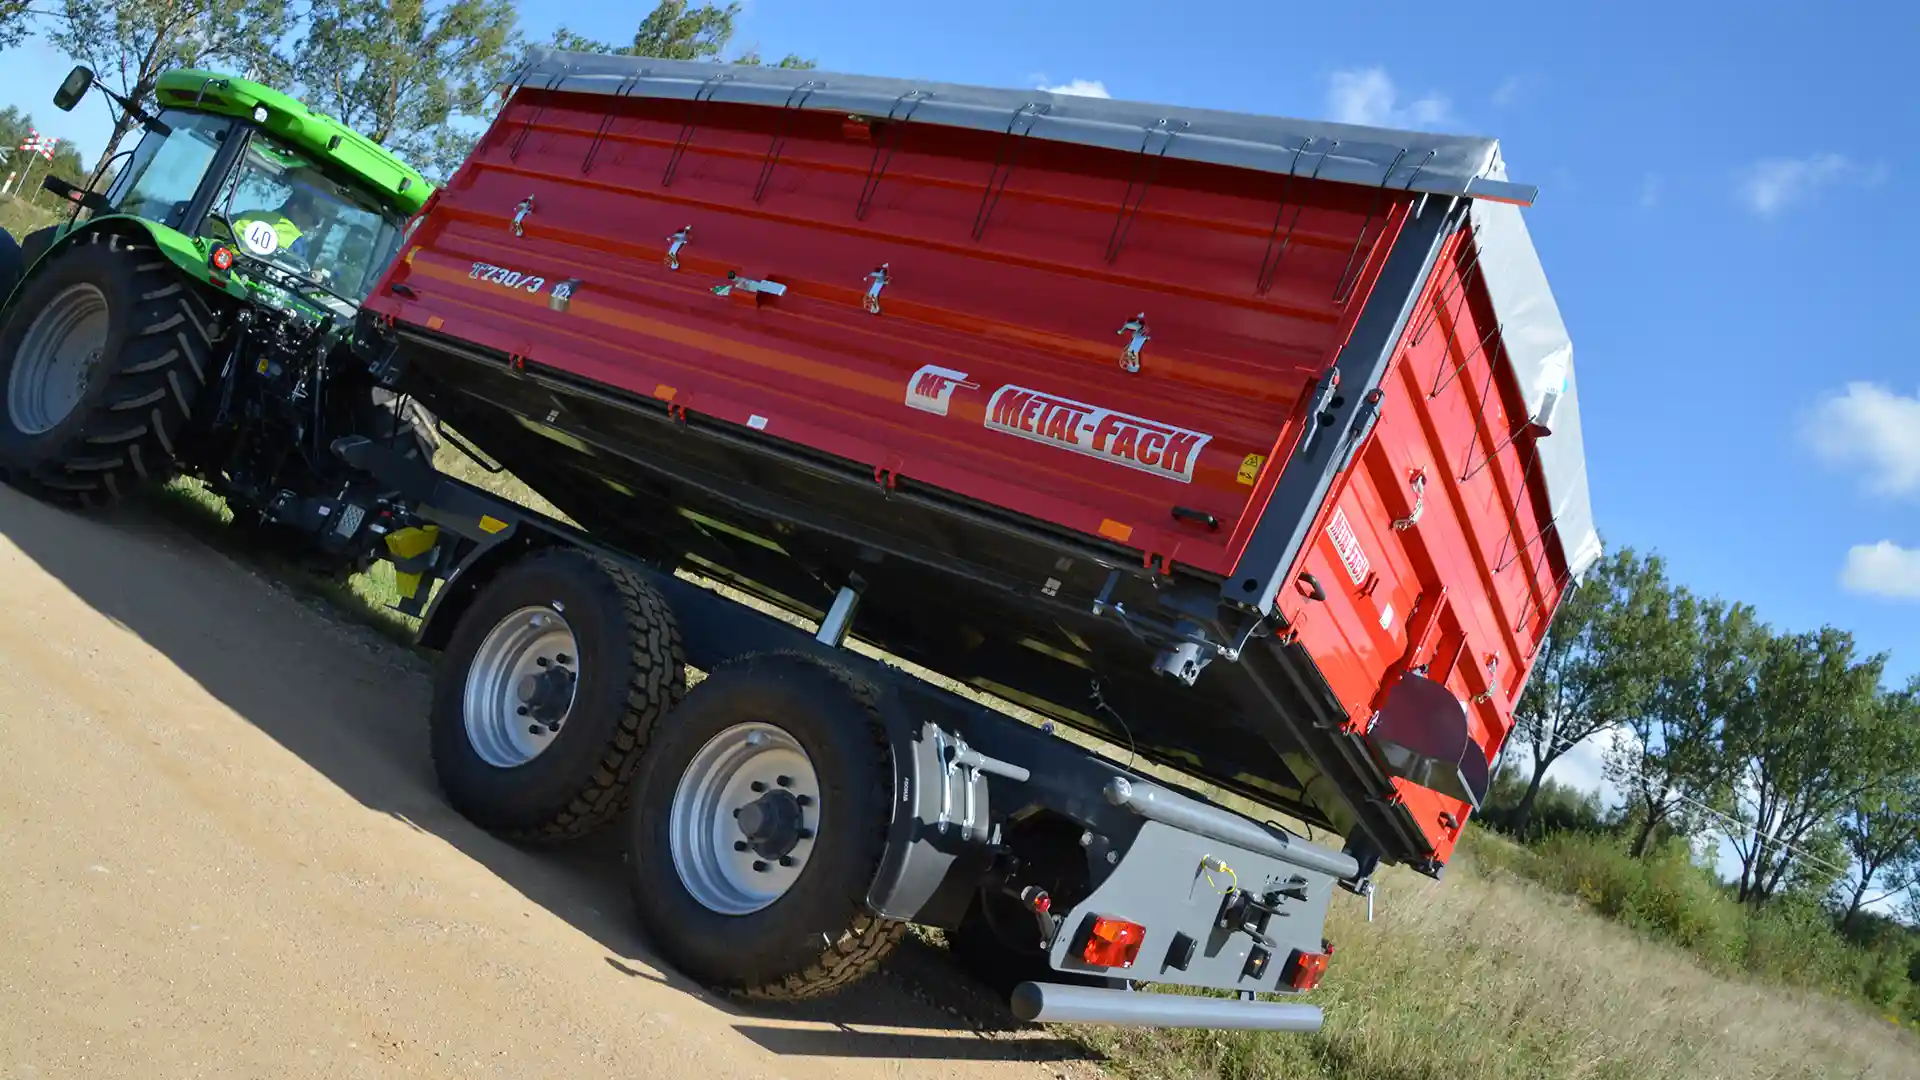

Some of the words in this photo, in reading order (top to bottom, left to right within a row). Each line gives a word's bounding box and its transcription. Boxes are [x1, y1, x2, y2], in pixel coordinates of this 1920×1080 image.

[251, 226, 271, 249] 40
[468, 261, 545, 293] T730/3
[914, 371, 960, 401] MF
[991, 387, 1202, 474] METAL-FACH
